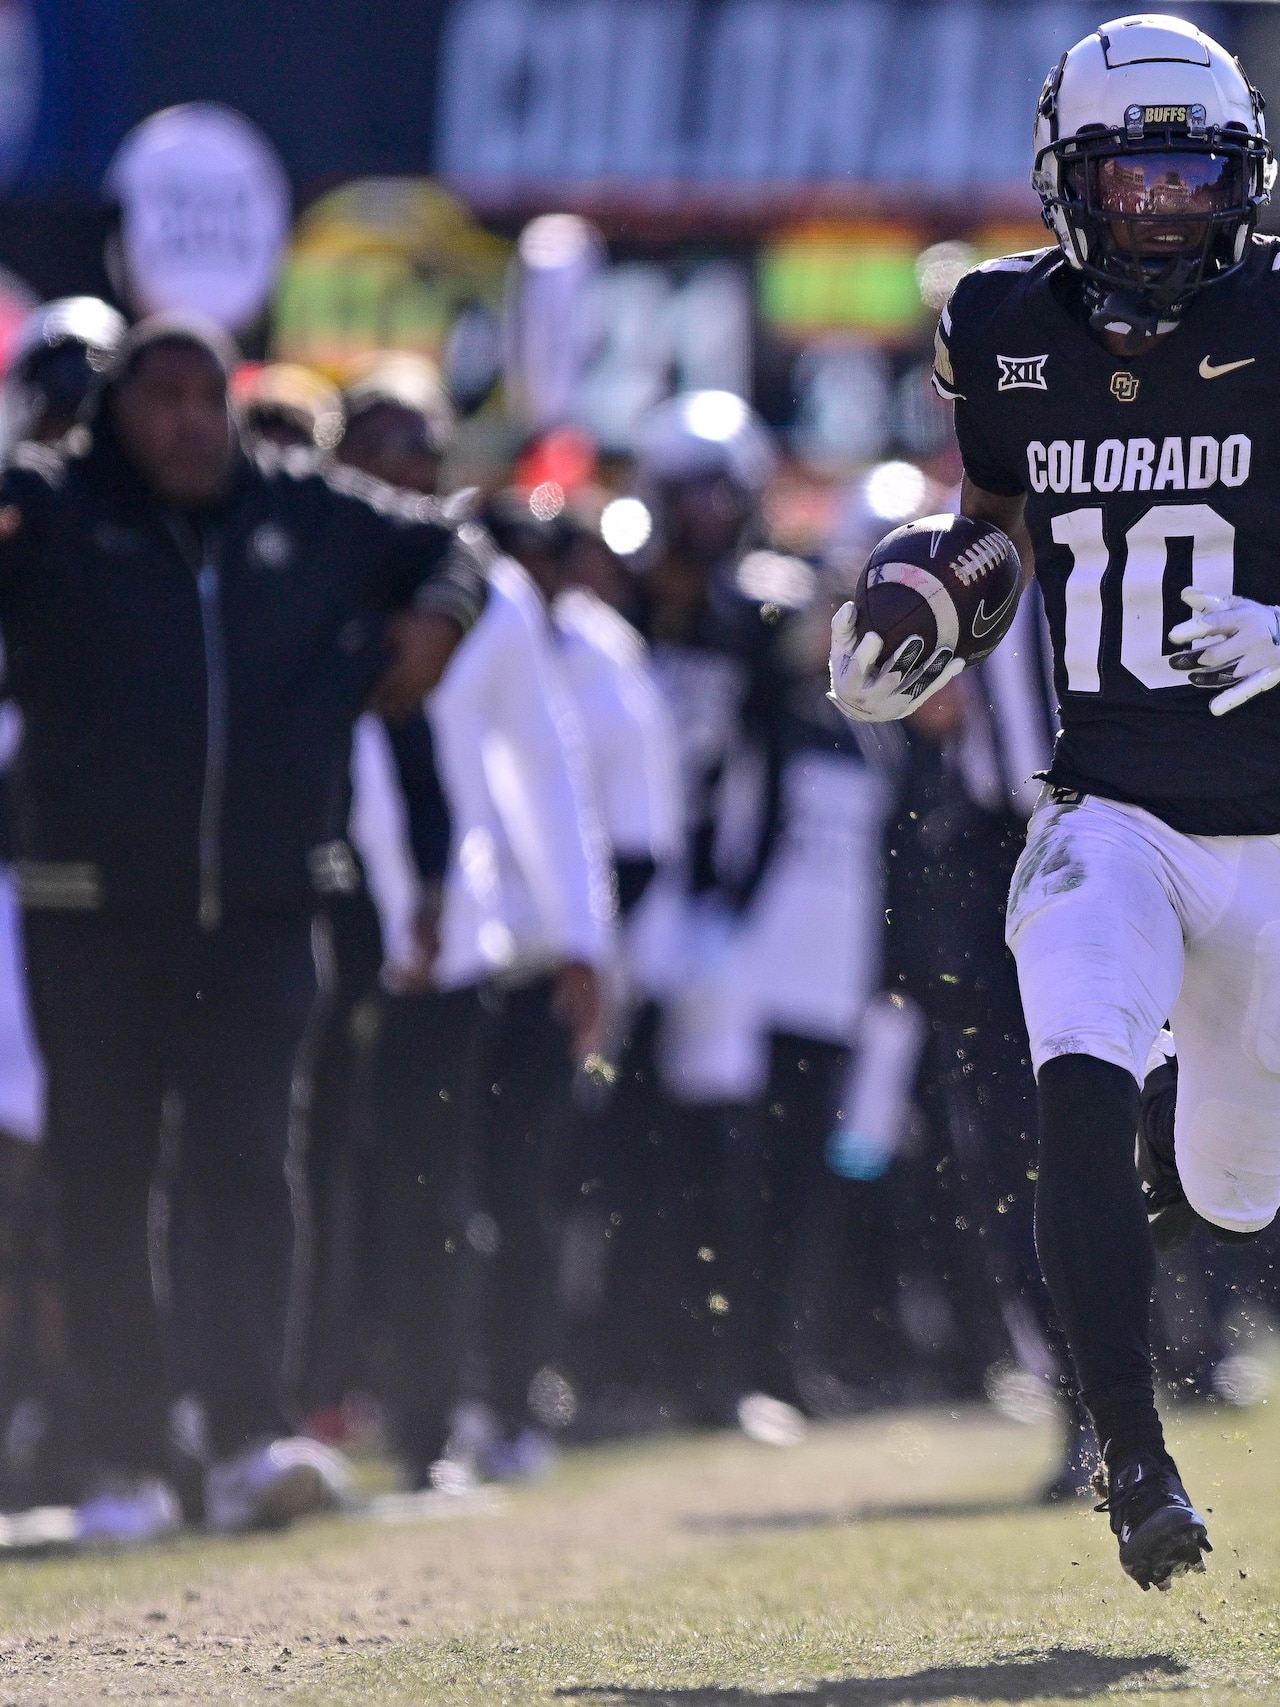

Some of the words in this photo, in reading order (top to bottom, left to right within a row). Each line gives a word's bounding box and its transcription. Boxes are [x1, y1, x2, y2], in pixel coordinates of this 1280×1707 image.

[1144, 107, 1187, 123] BUFFS
[1026, 433, 1252, 494] COLORADO
[1050, 503, 1236, 693] 10
